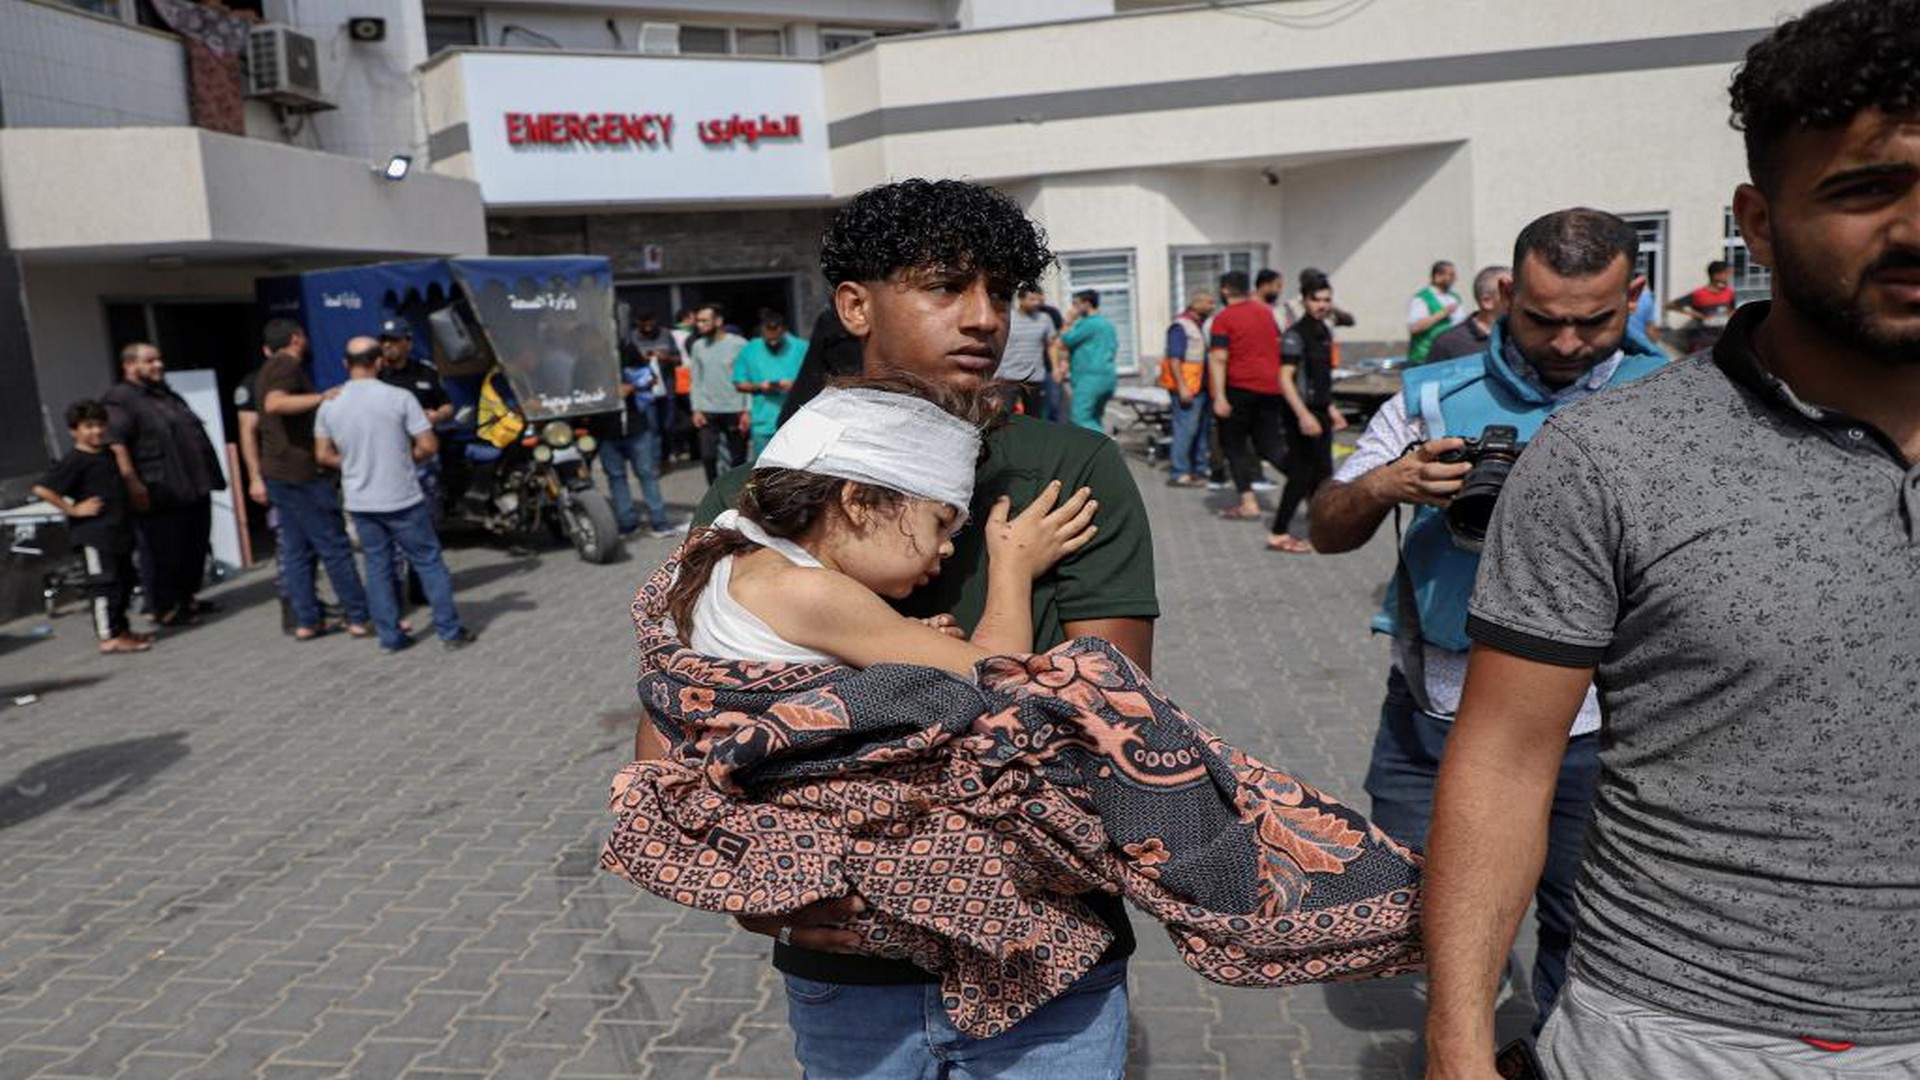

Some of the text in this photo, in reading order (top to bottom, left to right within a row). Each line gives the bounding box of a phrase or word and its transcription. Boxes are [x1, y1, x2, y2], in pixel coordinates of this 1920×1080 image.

[504, 111, 673, 146] EMERGENCY
[507, 292, 576, 311] وزارة الصحة
